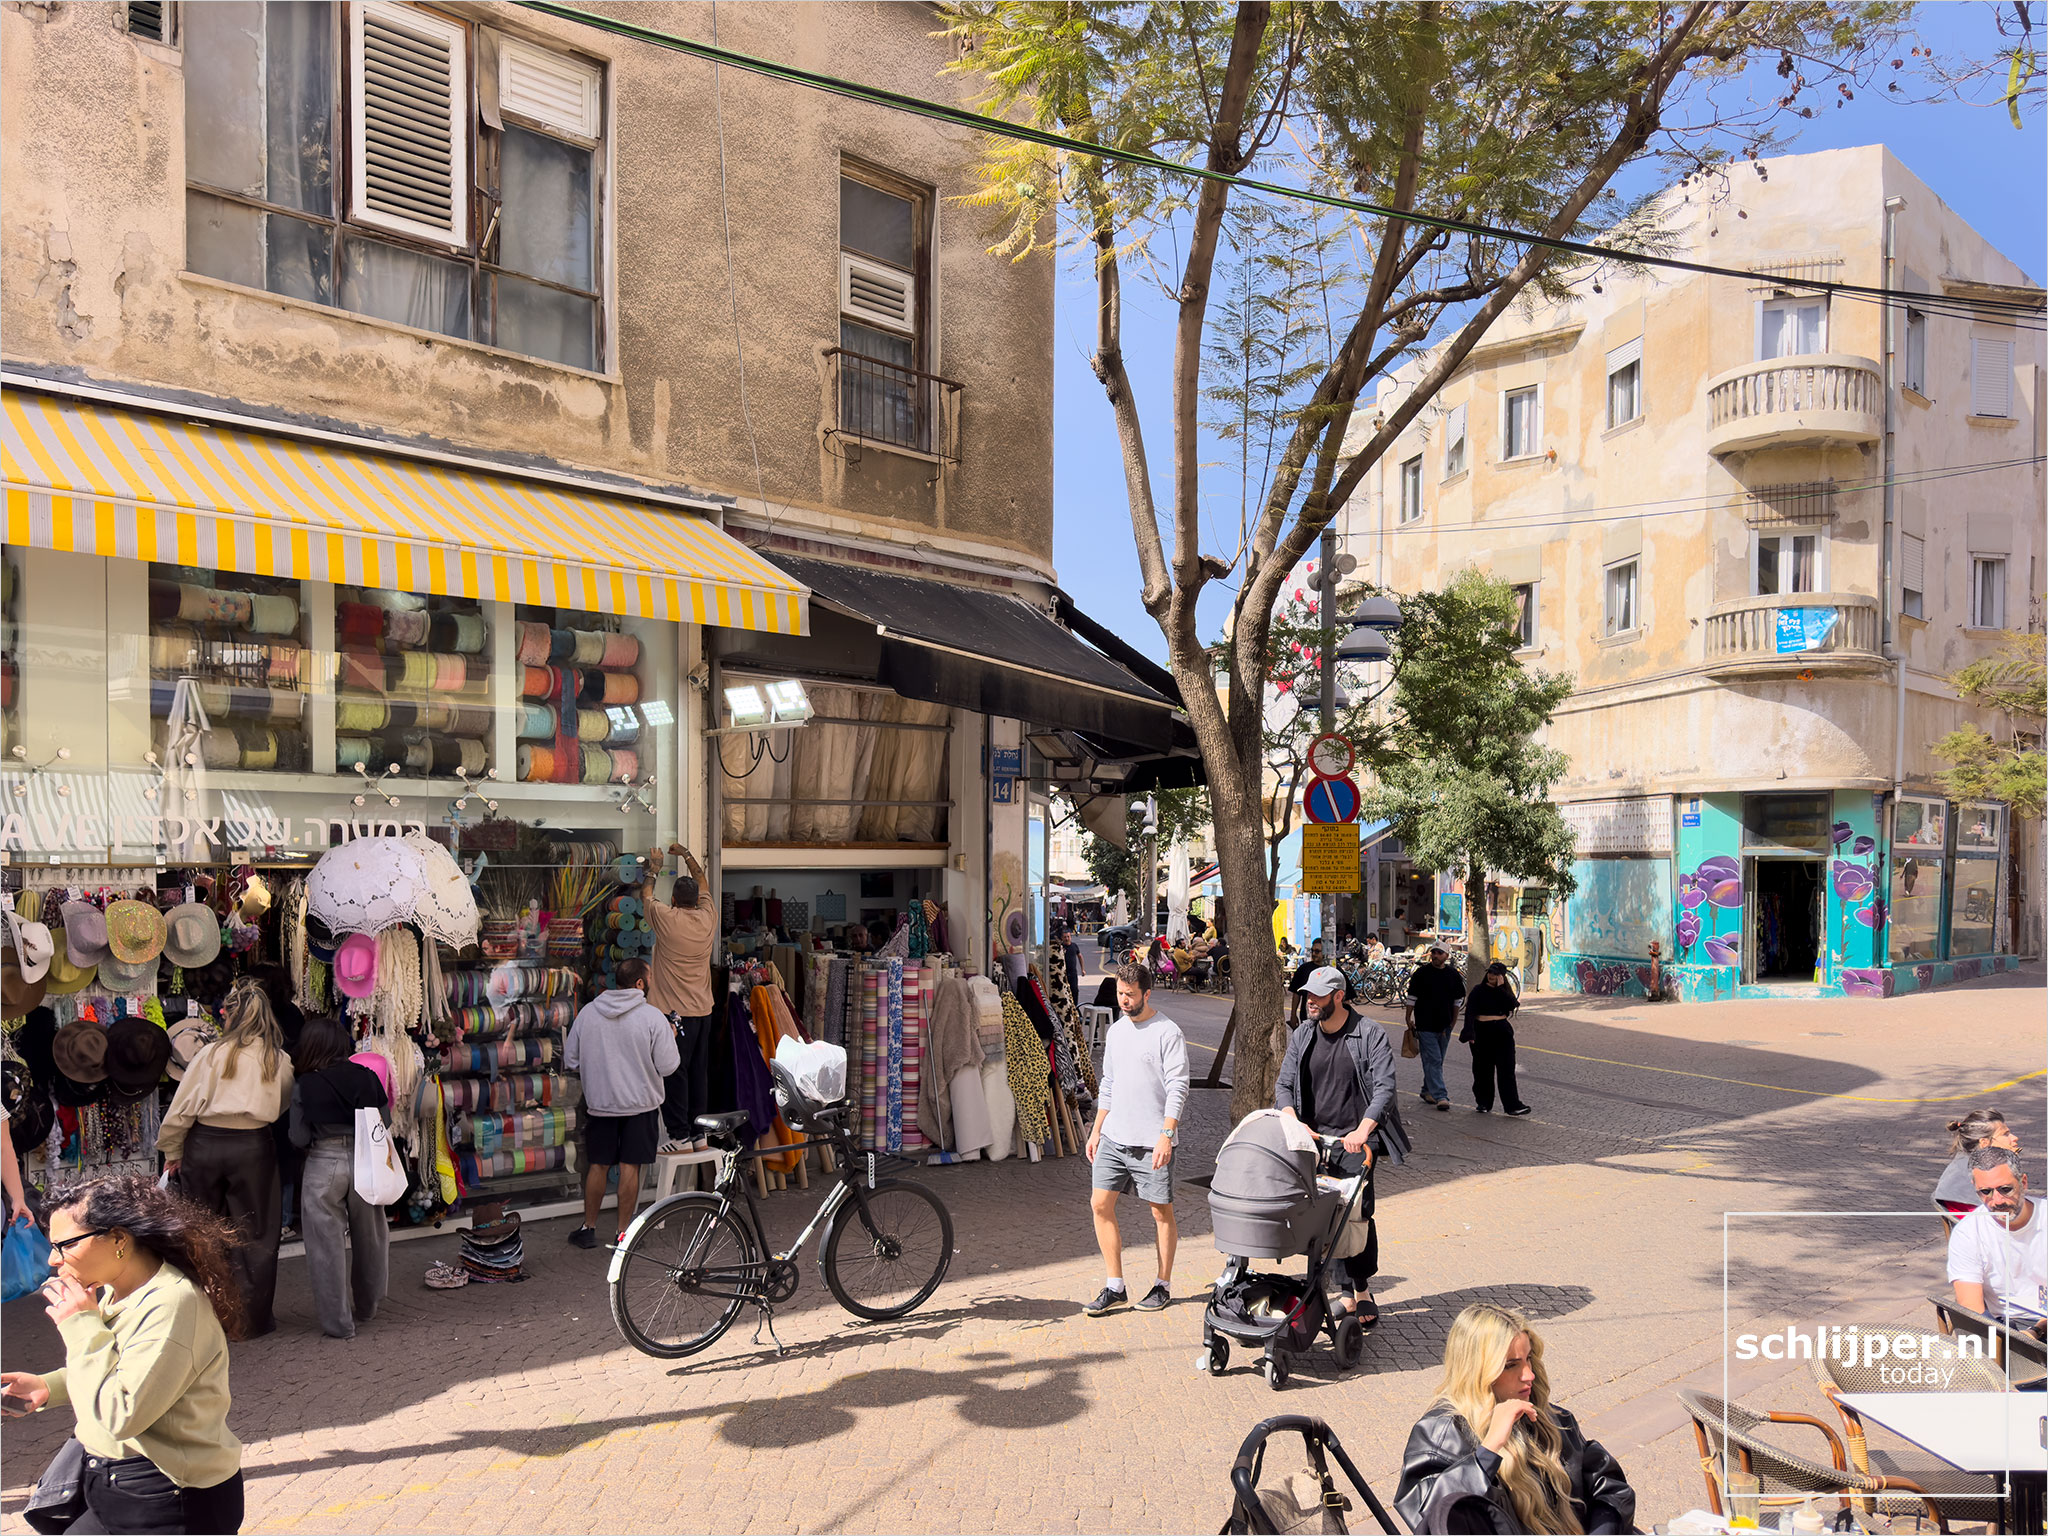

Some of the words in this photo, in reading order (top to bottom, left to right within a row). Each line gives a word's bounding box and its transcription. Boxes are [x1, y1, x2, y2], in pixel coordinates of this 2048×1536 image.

[994, 782, 1009, 800] 14
[113, 808, 221, 855] אלדין
[233, 808, 291, 846] של
